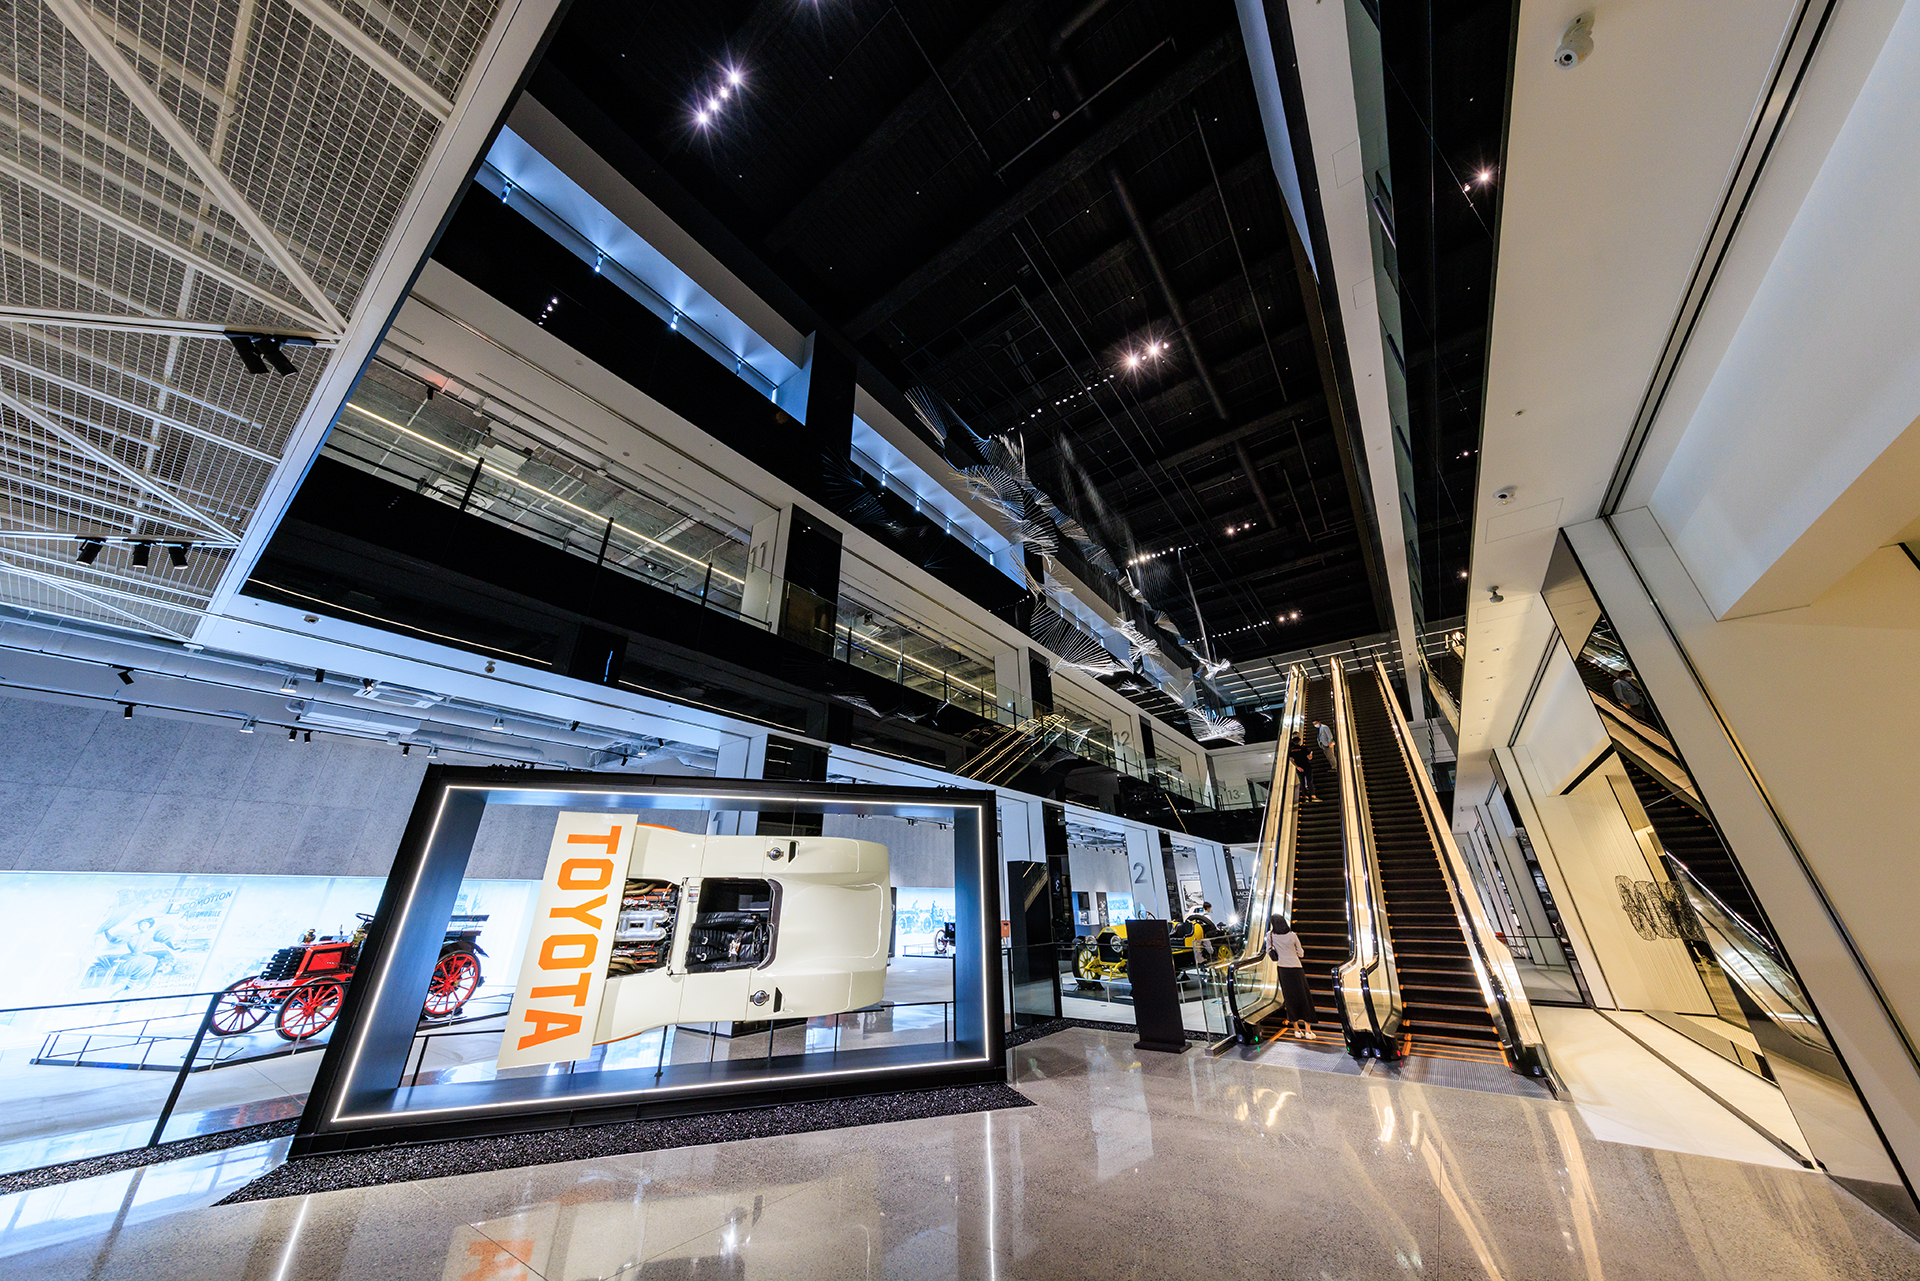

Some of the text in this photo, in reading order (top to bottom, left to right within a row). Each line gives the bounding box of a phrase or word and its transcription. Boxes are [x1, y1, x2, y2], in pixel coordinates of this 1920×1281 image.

[750, 540, 768, 573] 11
[1113, 731, 1130, 747] 12
[1227, 789, 1241, 800] 13
[1133, 862, 1148, 884] 2
[117, 887, 209, 907] EXPOSITION
[517, 826, 622, 1051] TOYOTA
